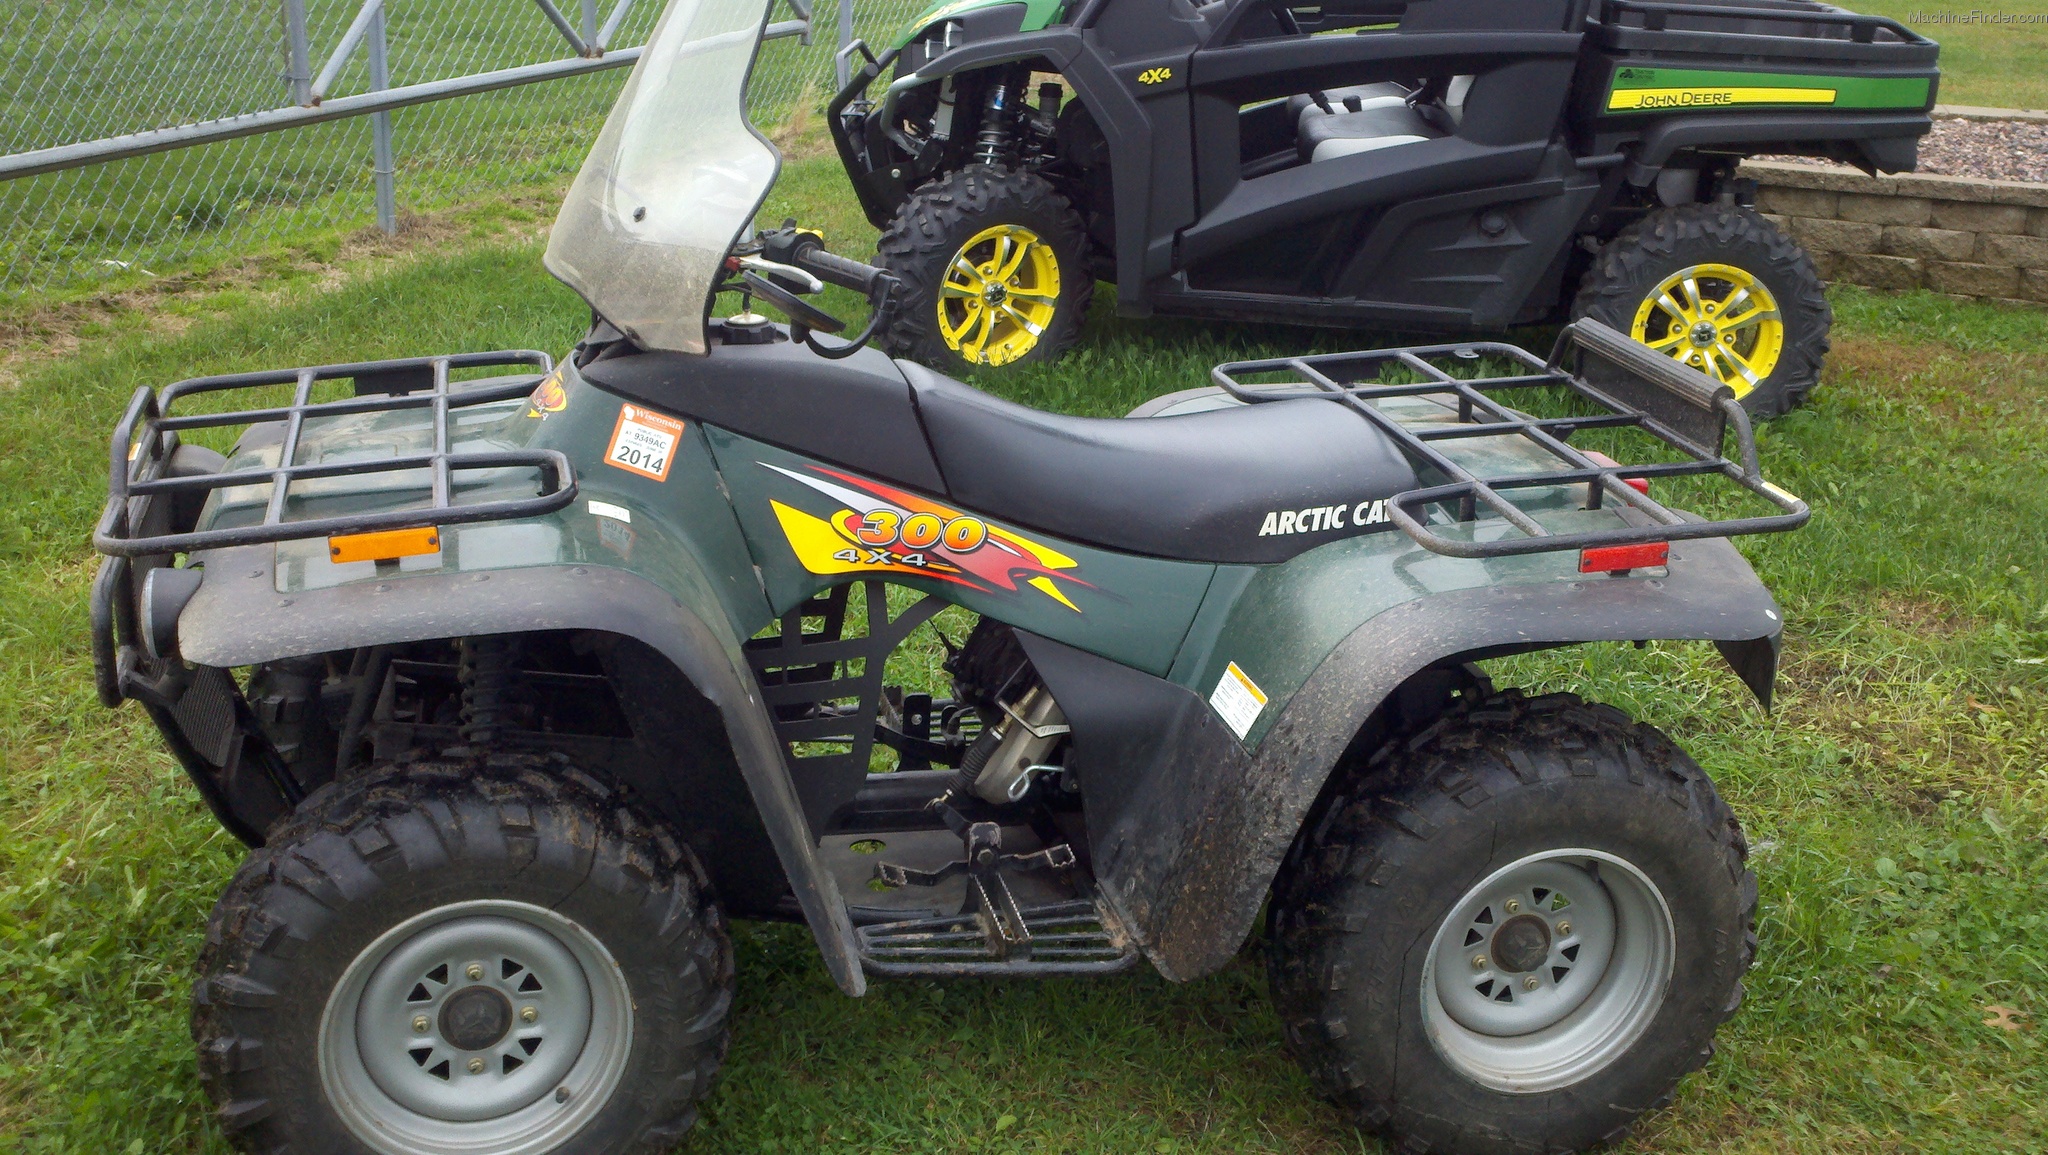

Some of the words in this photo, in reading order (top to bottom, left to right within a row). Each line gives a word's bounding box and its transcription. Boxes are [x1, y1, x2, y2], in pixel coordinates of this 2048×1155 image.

[1635, 94, 1677, 107] JOHN
[1681, 92, 1732, 104] DEERE
[636, 408, 682, 431] Wisconsin
[634, 432, 667, 450] 9349AC
[616, 445, 664, 473] 2014
[857, 509, 989, 552] 300
[1258, 504, 1348, 537] ARCTIC
